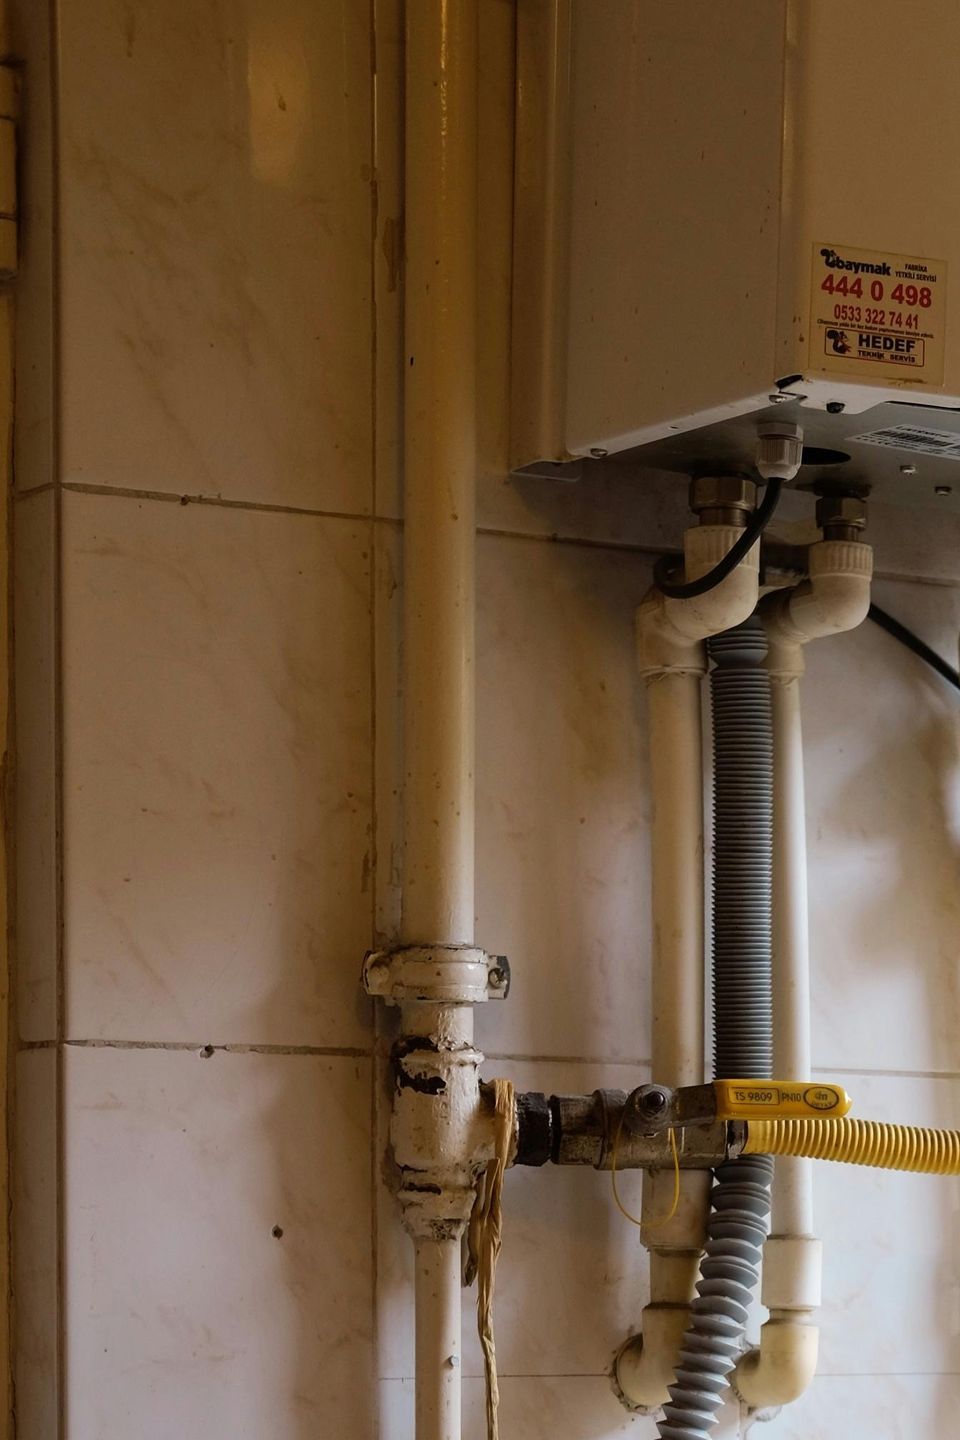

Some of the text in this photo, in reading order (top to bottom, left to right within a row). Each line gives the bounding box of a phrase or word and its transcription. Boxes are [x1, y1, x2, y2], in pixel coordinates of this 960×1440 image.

[821, 274, 934, 308] 444 0 498
[834, 304, 862, 323] 0533
[865, 307, 886, 326] 322
[889, 311, 903, 329] 74
[905, 313, 919, 330] 41
[858, 333, 917, 354] HEDEF
[735, 1090, 774, 1102] TS 9809
[781, 1092, 802, 1103] PN10
